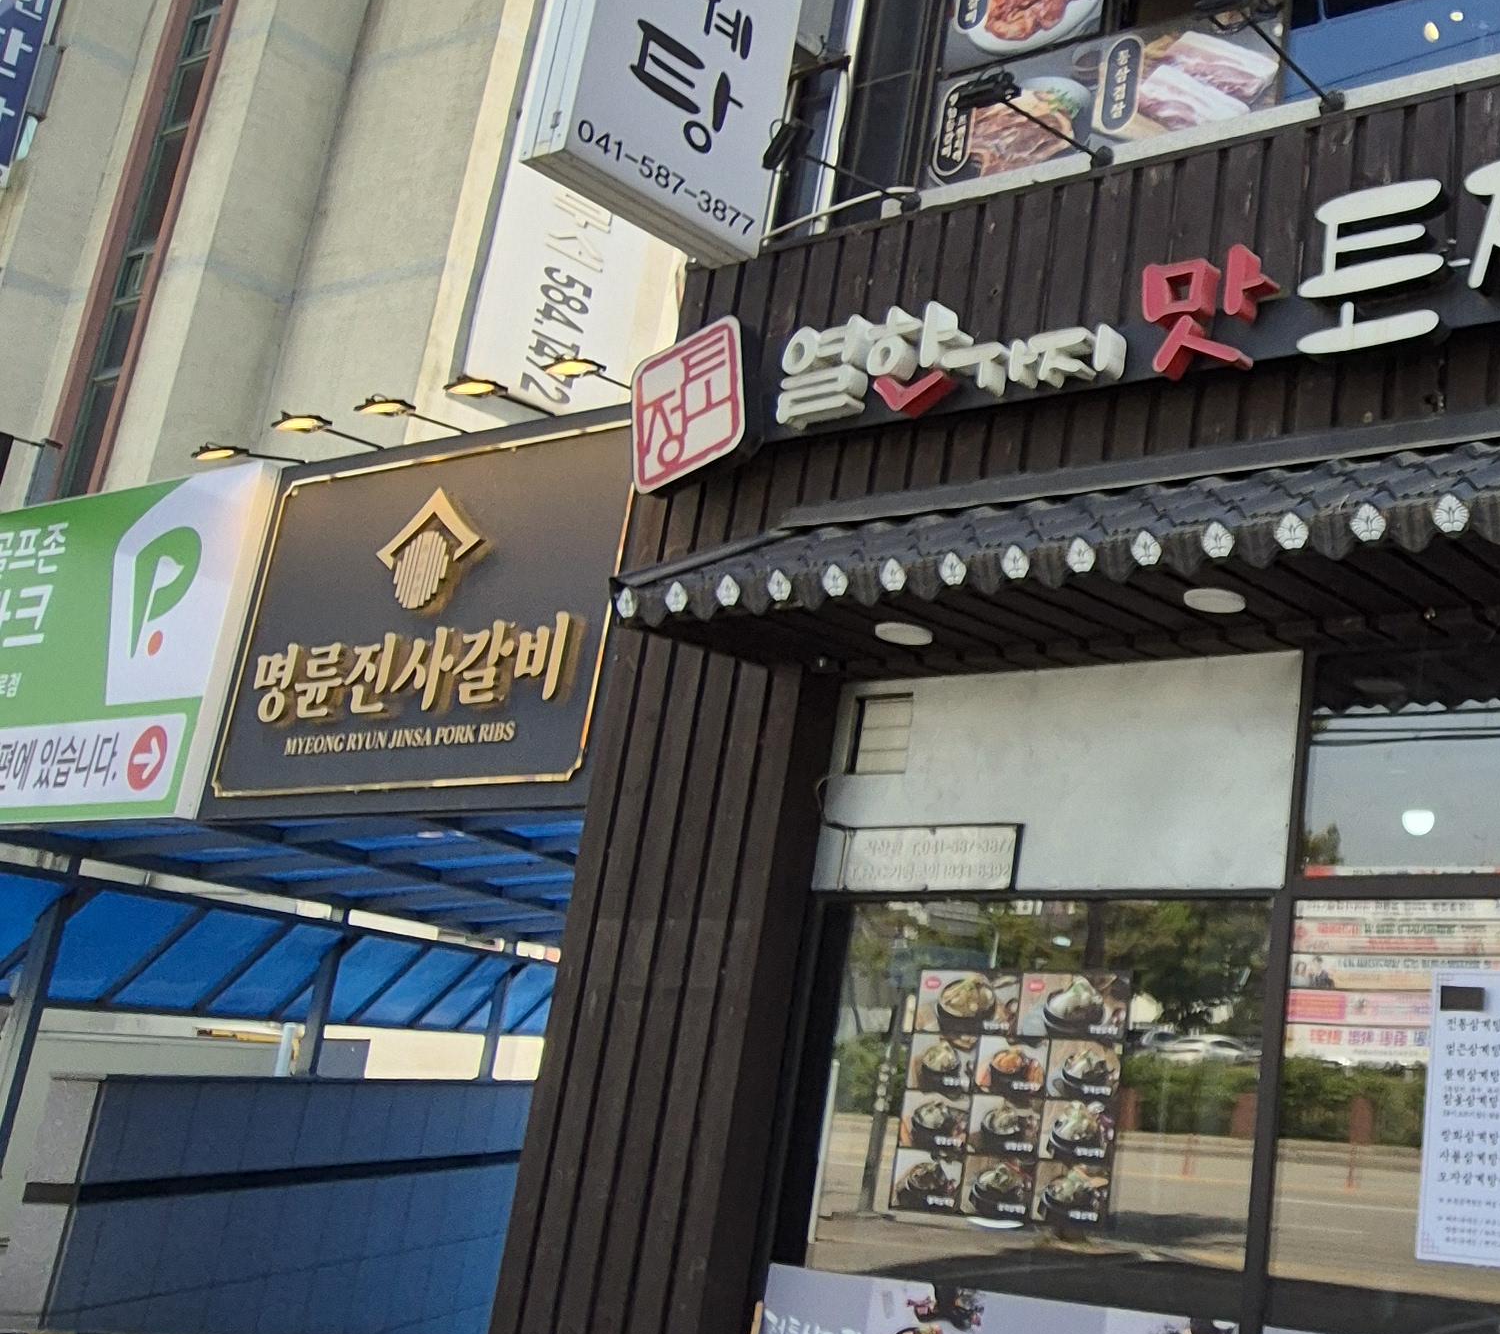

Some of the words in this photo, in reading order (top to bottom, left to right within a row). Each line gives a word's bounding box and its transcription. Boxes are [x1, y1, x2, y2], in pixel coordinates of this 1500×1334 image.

[576, 118, 756, 238] 041-587-3877
[1140, 243, 1284, 380] 맛
[252, 610, 571, 723] 명륜진사갈비
[32, 732, 119, 791] 있습니다.
[284, 733, 346, 756] MYEONG
[345, 729, 389, 752] RYUN
[387, 726, 433, 749] JINSA
[433, 723, 476, 746] PORK
[477, 720, 516, 743] RIBS
